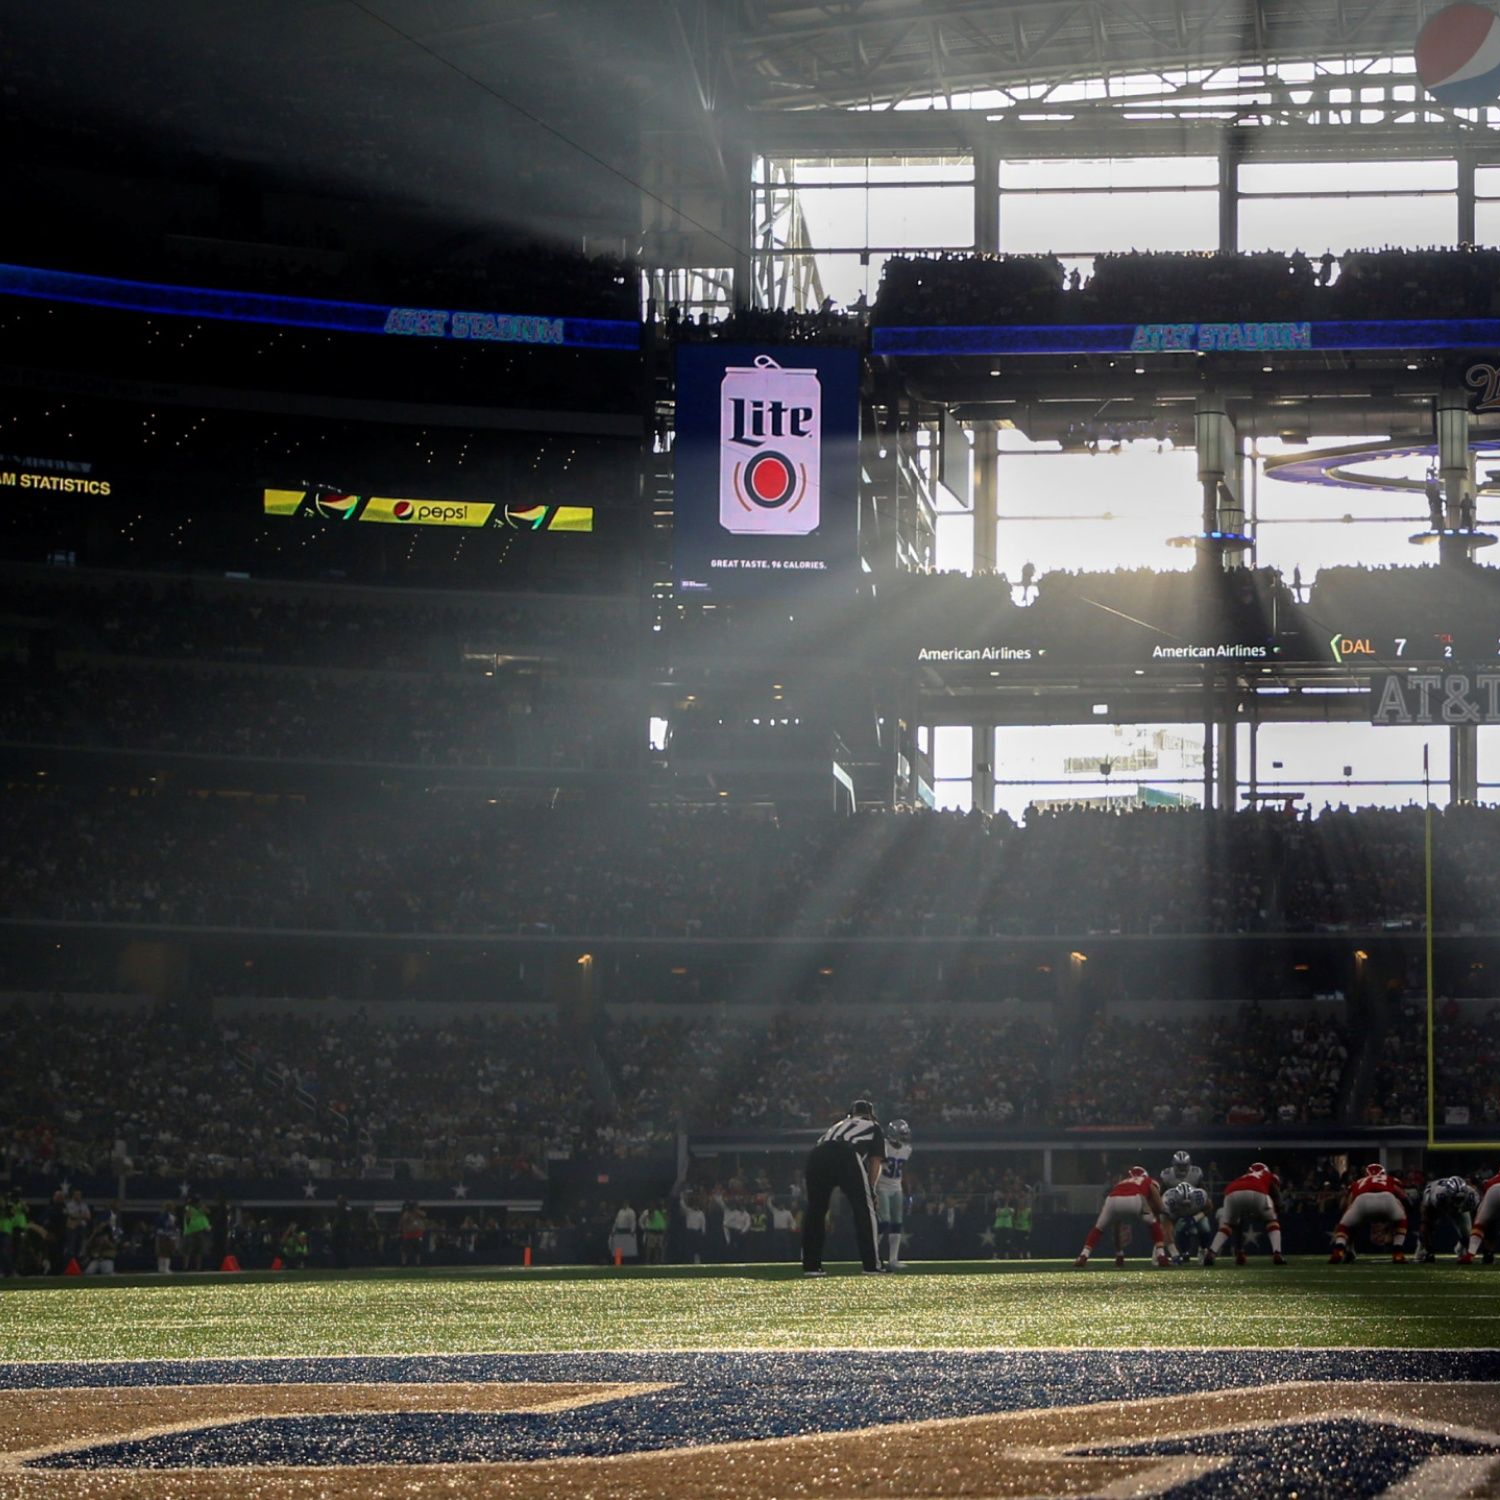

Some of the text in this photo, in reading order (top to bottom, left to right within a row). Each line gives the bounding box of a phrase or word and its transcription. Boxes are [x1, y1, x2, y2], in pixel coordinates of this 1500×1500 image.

[384, 307, 564, 344] AT&T STADIUM
[1131, 322, 1312, 350] AT&T STADIUM
[728, 398, 813, 447] Lite
[0, 472, 112, 496] M STATISTICS
[418, 505, 468, 521] pepsi
[711, 560, 739, 568] GREAT
[740, 560, 770, 569] TASTE.
[783, 561, 827, 569] CALORIES.
[918, 647, 1031, 660] American Airlines
[1152, 645, 1266, 658] American Airlines
[1341, 638, 1407, 656] DAL 7
[1444, 646, 1452, 657] 2
